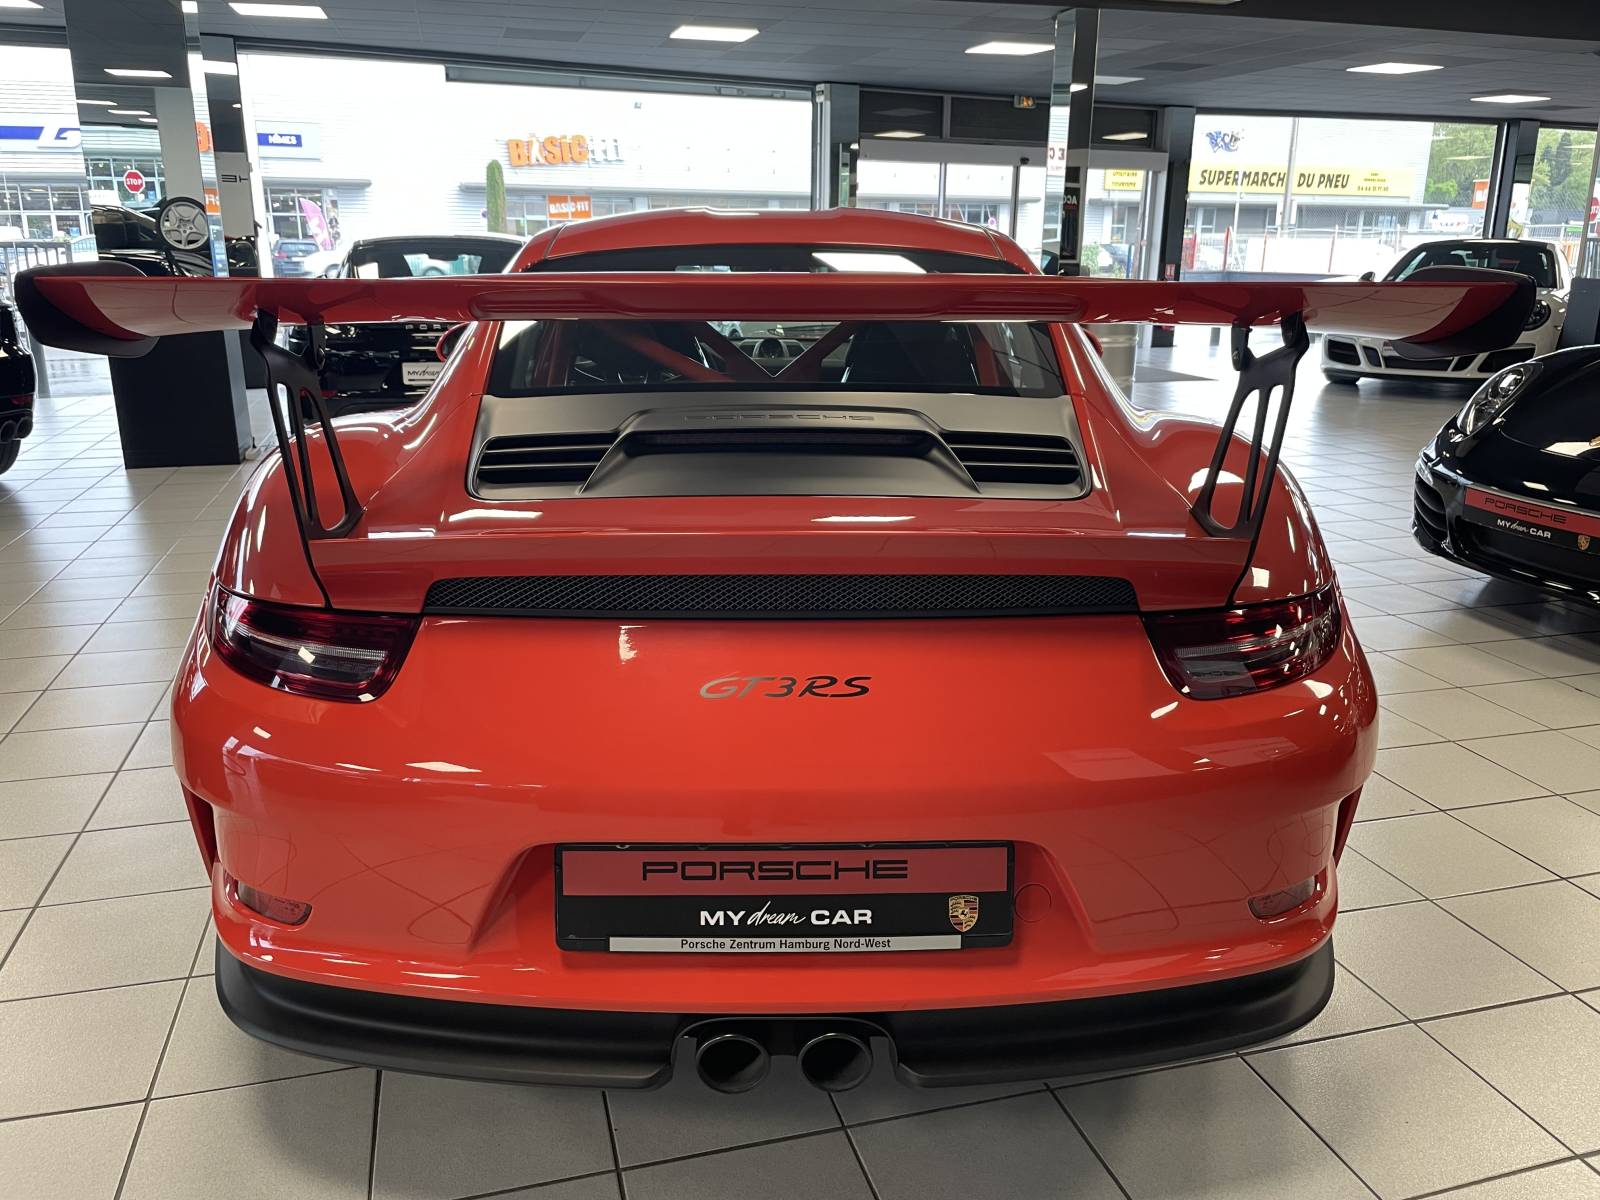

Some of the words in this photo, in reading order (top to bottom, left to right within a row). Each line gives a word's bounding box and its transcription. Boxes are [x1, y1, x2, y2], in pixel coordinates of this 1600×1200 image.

[126, 178, 142, 186] STOP
[1199, 169, 1287, 187] SUPERMARCH
[1297, 172, 1316, 188] DU
[1317, 173, 1350, 189] PNEU
[1484, 497, 1567, 524] PORSCHE
[1497, 519, 1512, 529] MY
[1529, 527, 1552, 539] CAR
[642, 860, 908, 881] PORSCHE
[700, 909, 746, 926] MY
[746, 901, 806, 926] dream
[810, 909, 873, 926] CAR
[681, 938, 726, 949] Porsche
[729, 938, 776, 949] Zentrum
[779, 938, 830, 950] Hamburg
[833, 938, 891, 949] Nord-West
